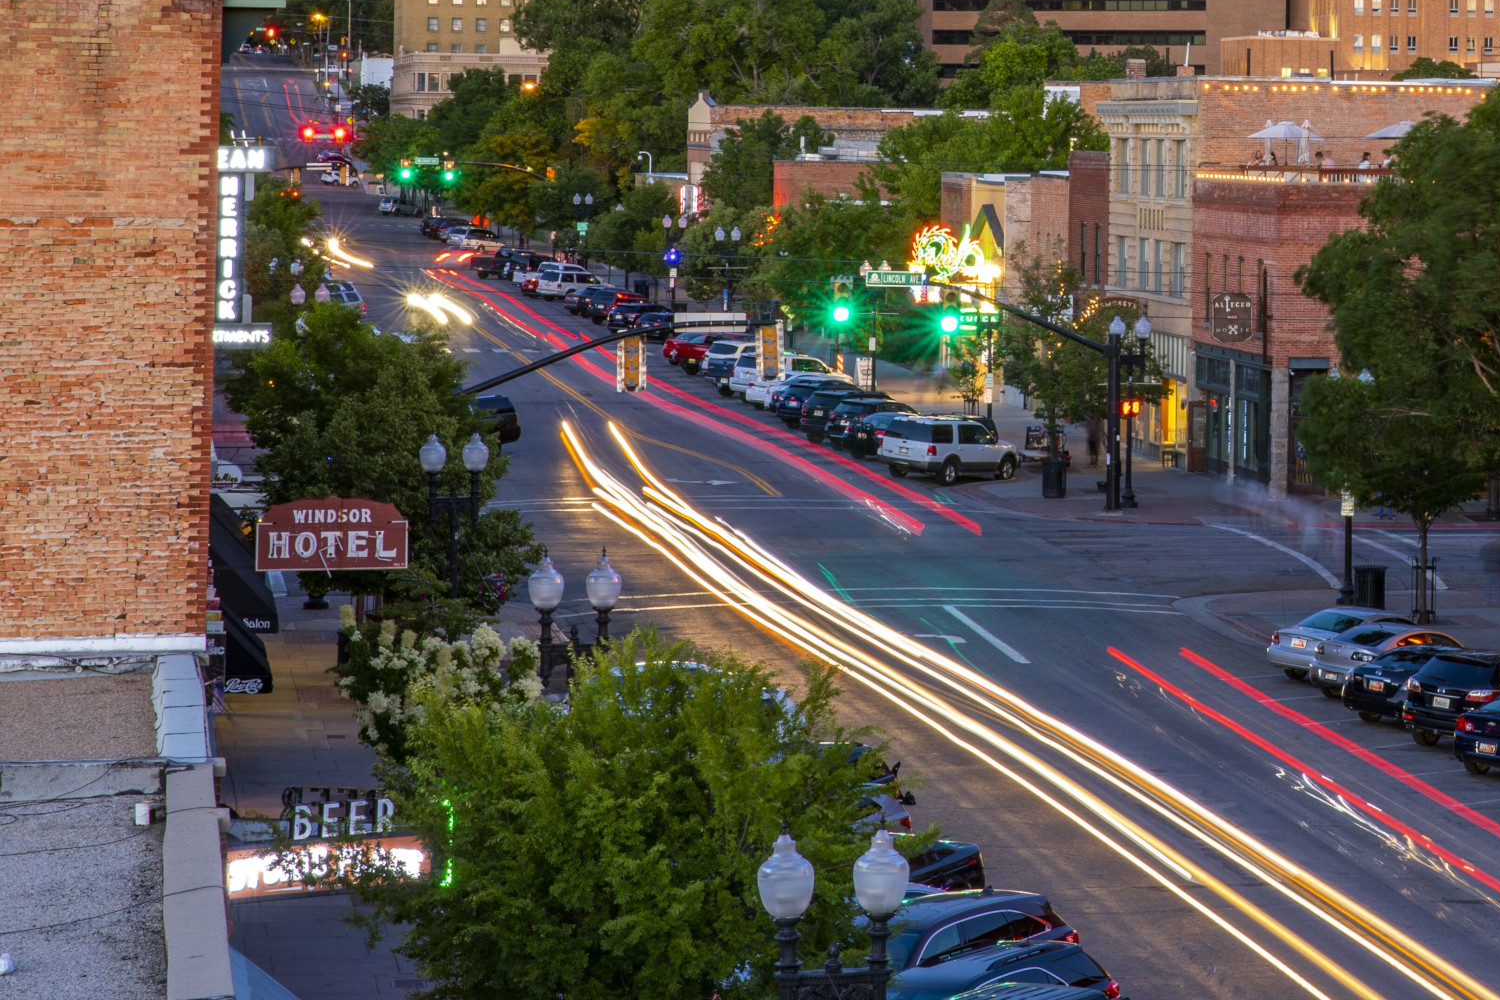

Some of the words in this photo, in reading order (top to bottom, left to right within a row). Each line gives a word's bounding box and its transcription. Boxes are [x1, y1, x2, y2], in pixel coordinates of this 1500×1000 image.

[883, 272, 906, 284] LINCOLN
[293, 508, 372, 524] WINDSOR
[268, 530, 397, 559] HOTEL
[243, 617, 271, 629] Salon
[292, 797, 395, 840] BEER
